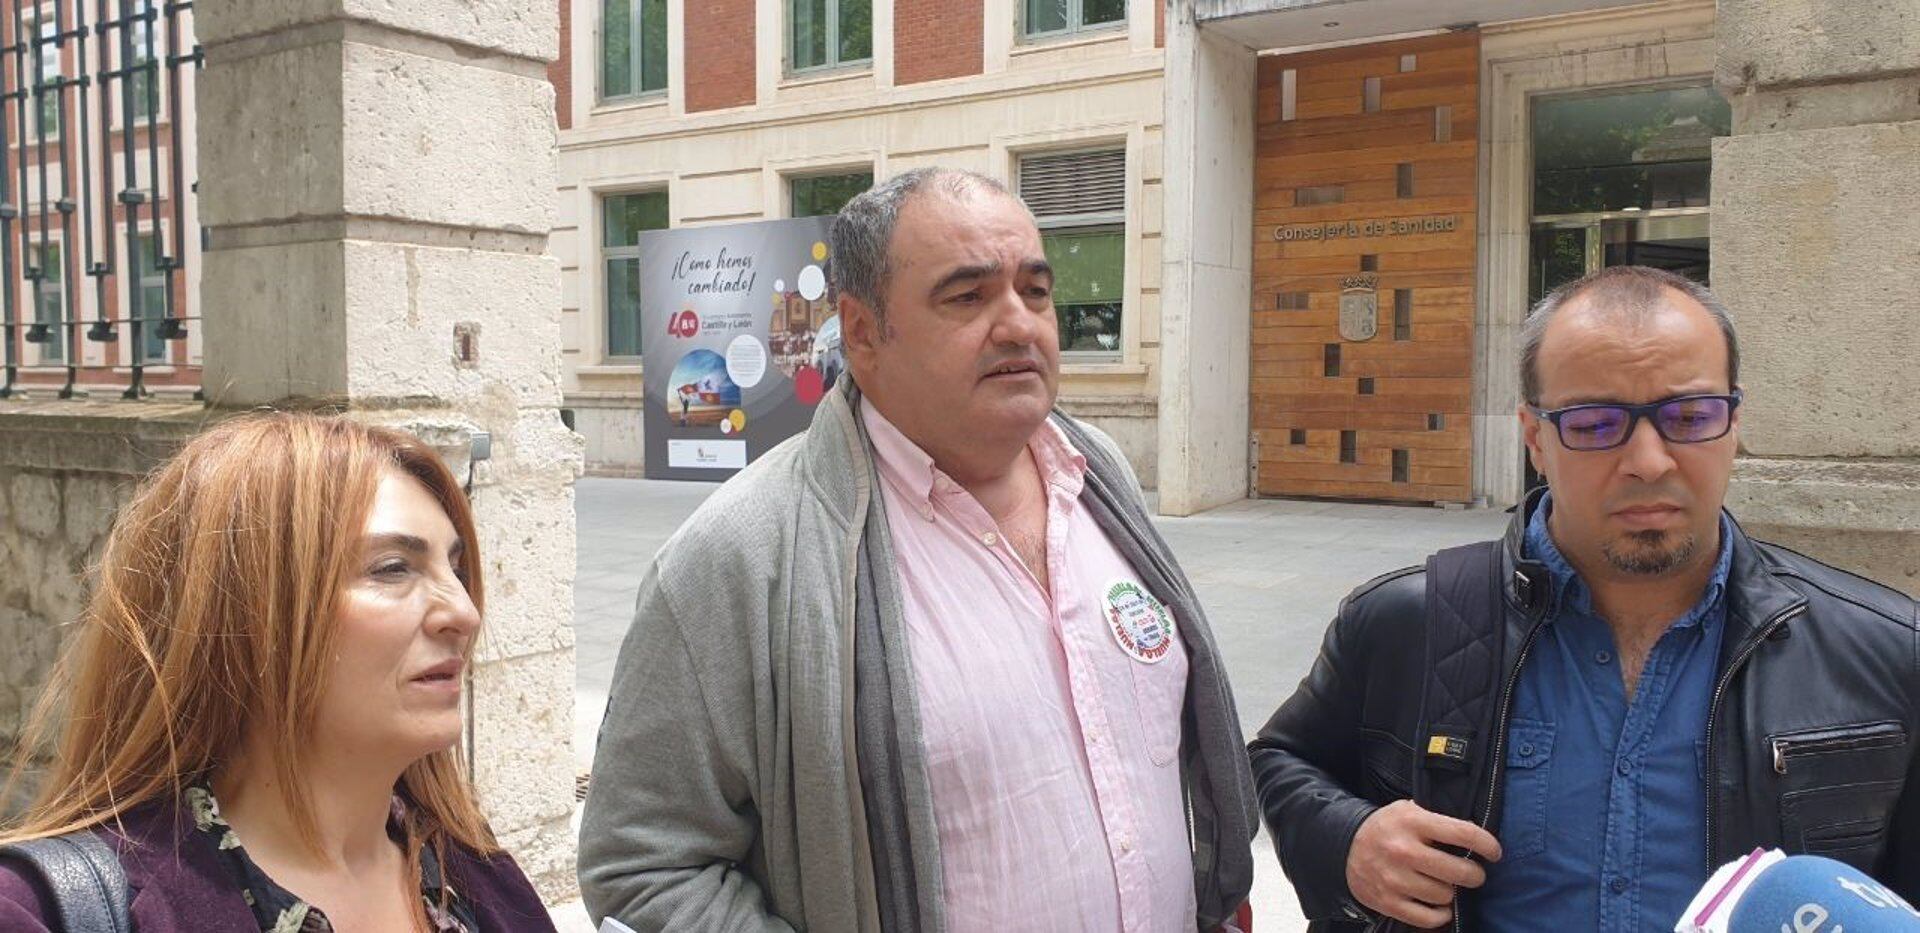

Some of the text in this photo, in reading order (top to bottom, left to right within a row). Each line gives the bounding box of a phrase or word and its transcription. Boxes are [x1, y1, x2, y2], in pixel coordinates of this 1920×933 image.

[1364, 220, 1385, 237] de
[1389, 215, 1456, 234] Sanidad
[717, 246, 752, 269] hemos
[687, 269, 756, 297] cambiado!
